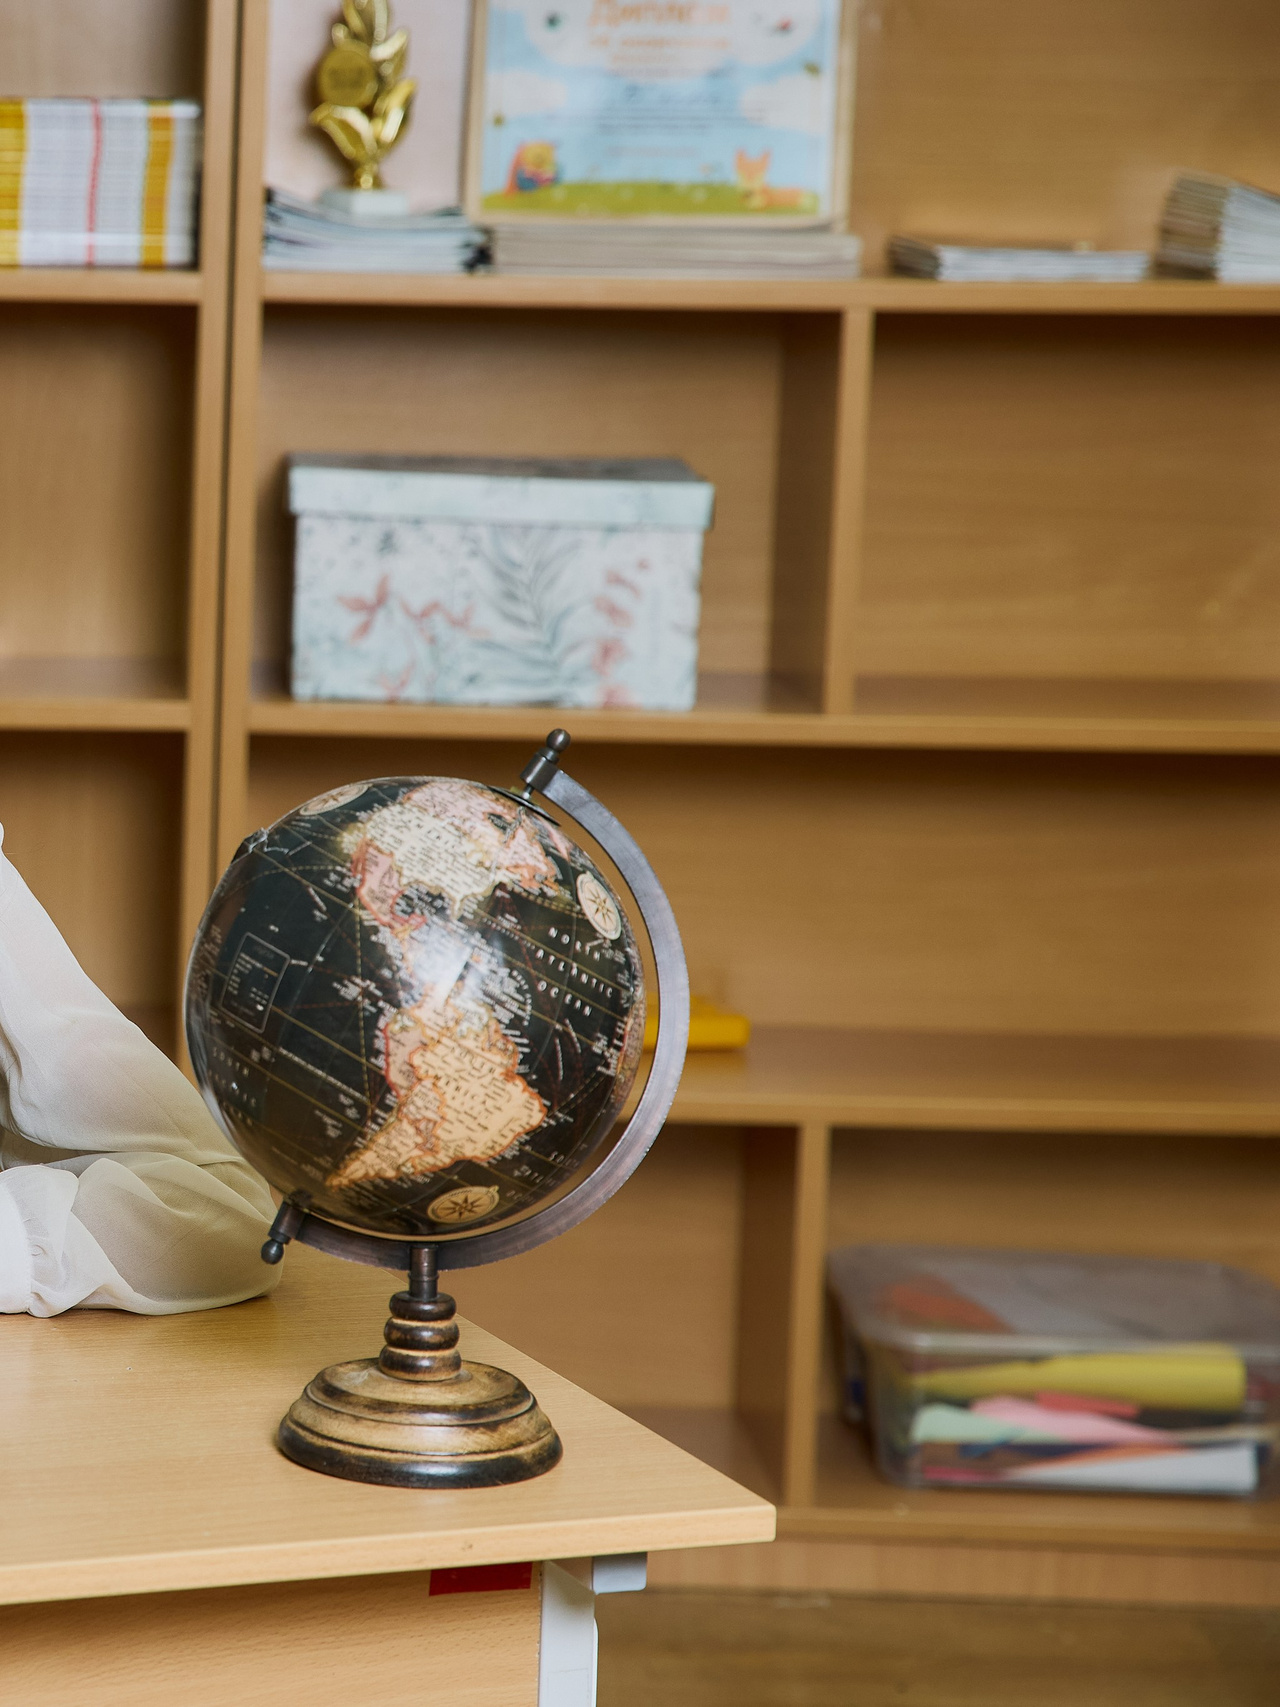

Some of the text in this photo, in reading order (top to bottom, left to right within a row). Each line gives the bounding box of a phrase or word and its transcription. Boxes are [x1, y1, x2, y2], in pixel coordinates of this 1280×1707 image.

[548, 927, 601, 962] NORTH
[535, 949, 613, 998] ATLANTIC
[537, 980, 593, 1017] OCEAN
